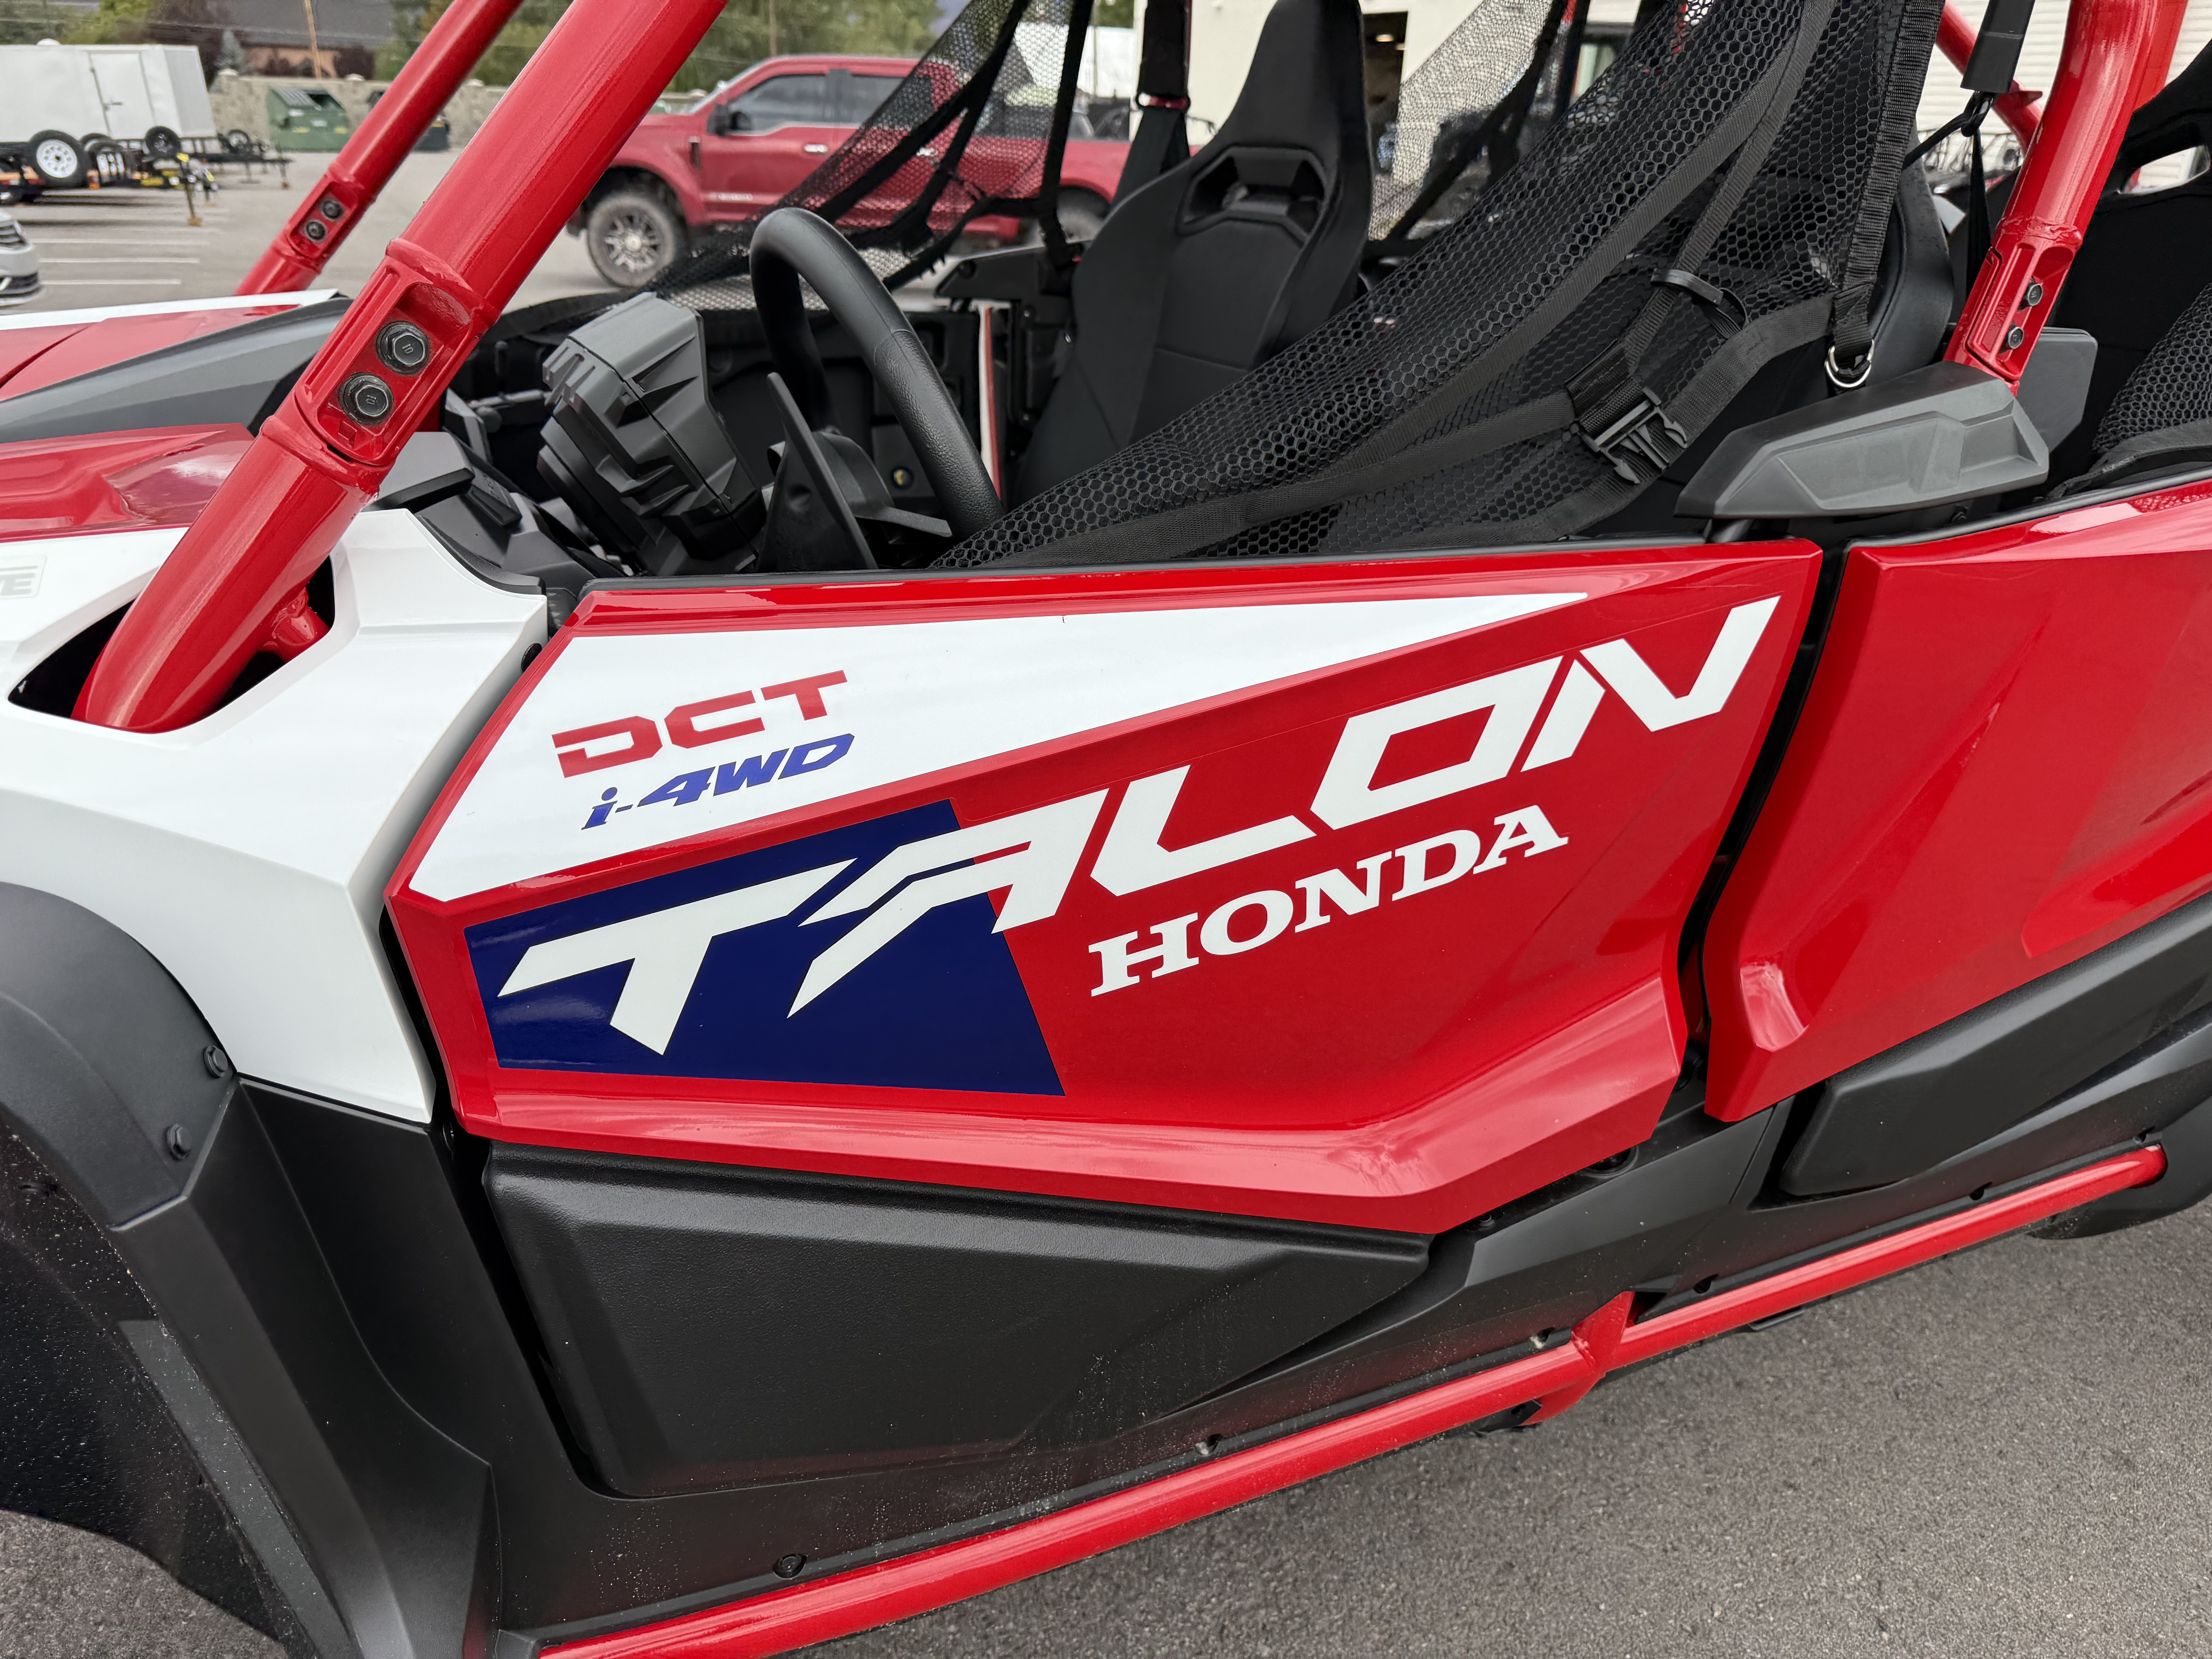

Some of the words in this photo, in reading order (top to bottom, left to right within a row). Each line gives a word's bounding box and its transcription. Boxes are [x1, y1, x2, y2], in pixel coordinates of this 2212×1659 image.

[552, 670, 847, 778] DCT
[581, 733, 855, 830] i-4WD
[497, 596, 1781, 1056] TALON
[1089, 805, 1568, 997] HONDA
